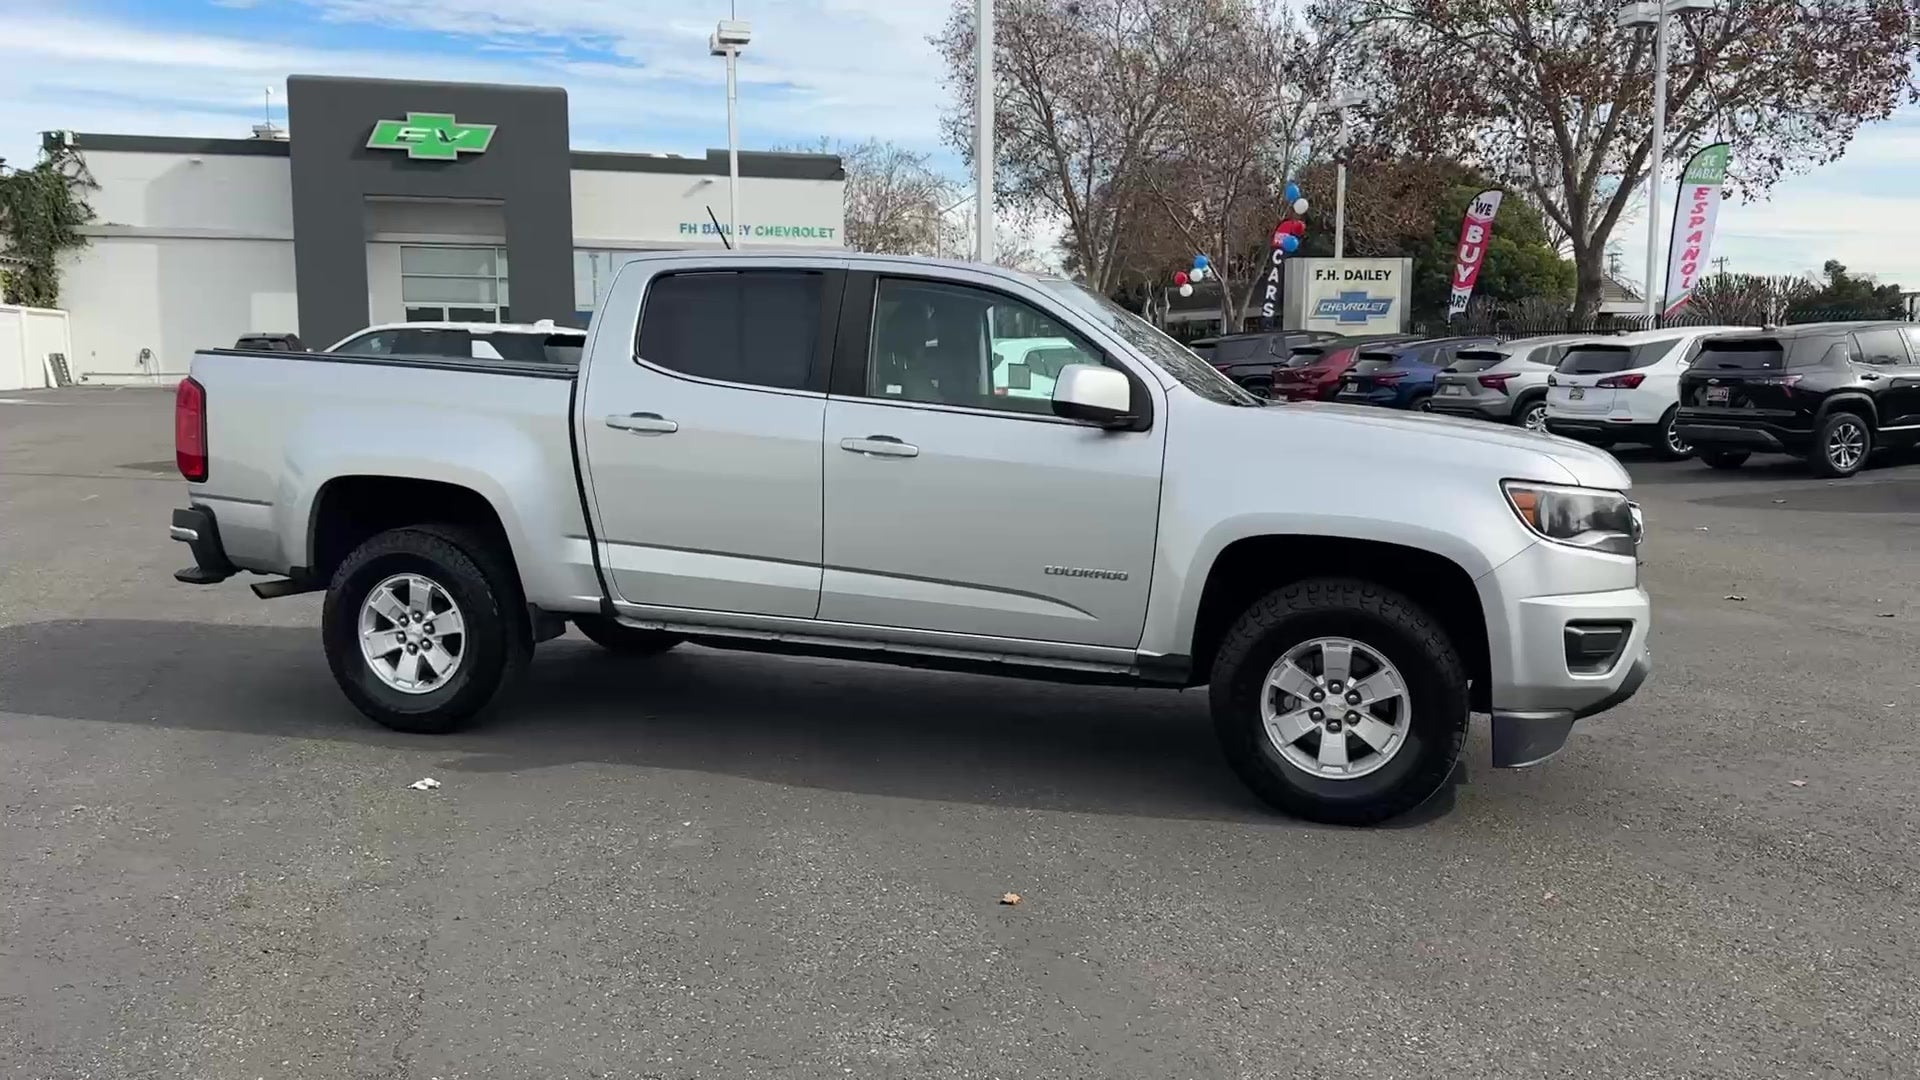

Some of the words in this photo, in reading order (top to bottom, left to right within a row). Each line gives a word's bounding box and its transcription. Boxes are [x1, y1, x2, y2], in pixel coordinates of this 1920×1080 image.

[395, 127, 470, 143] EV
[1701, 155, 1719, 168] SE
[1686, 168, 1724, 180] HABLA
[1474, 202, 1493, 216] WE
[679, 223, 698, 234] FH
[755, 225, 836, 238] CHEVROLET
[1457, 224, 1485, 282] BUY
[1316, 270, 1340, 281] F.H.
[1344, 270, 1392, 281] DAILEY
[1262, 249, 1284, 318] CARS
[1319, 301, 1389, 312] CHEVROLET
[1044, 565, 1128, 581] COLORADO
